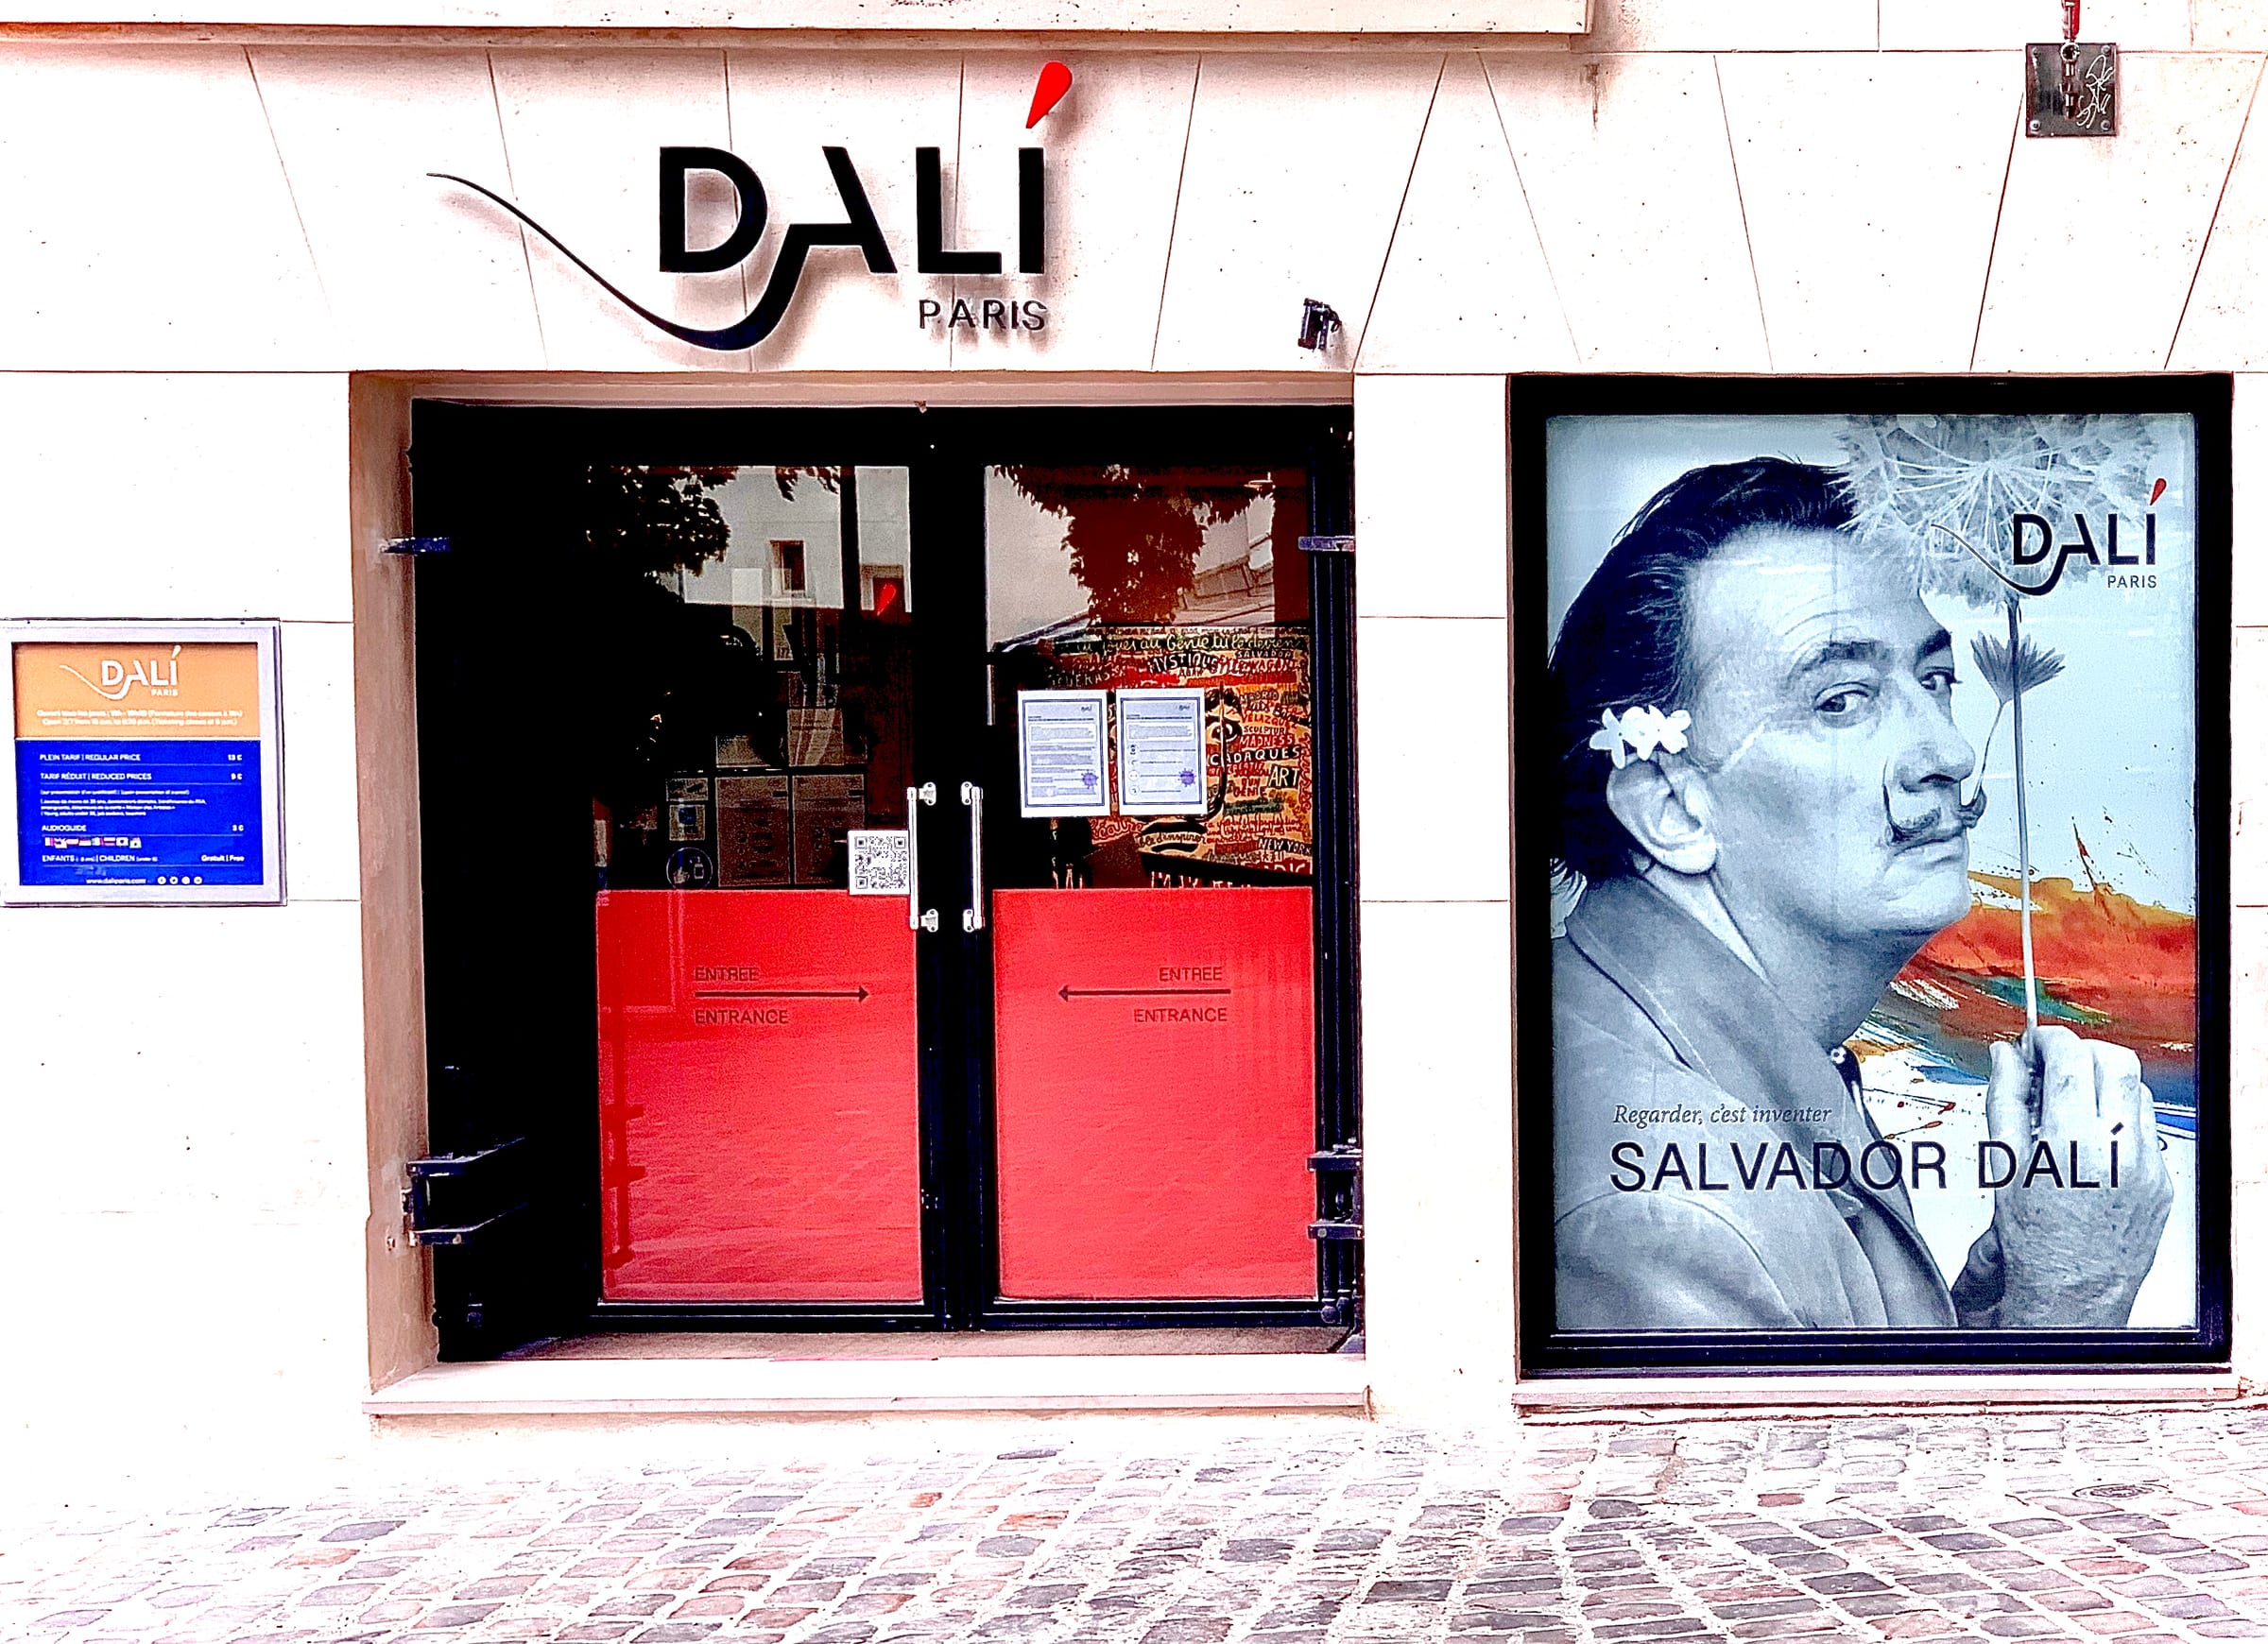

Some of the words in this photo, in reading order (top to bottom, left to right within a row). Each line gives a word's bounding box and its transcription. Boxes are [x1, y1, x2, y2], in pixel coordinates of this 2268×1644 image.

[659, 60, 1074, 351] DALÍ
[919, 299, 1047, 331] PARIS
[2013, 478, 2167, 595] DALÍ
[2106, 574, 2157, 589] PARIS
[100, 644, 181, 700] DALÍ
[1240, 734, 1295, 747] MADNESS
[1211, 745, 1300, 766] CADAQUES
[1268, 765, 1300, 787] ART
[695, 968, 759, 983] ENTREE
[1159, 967, 1223, 982] ENTREE
[695, 1009, 789, 1025] ENTRANCE
[1134, 1008, 1228, 1023] ENTRANCE
[1613, 1104, 1704, 1128] Regarder,
[1753, 1105, 1832, 1123] inventer
[1610, 1139, 1948, 1192] SALVADOR
[1978, 1122, 2121, 1190] DALÍ
